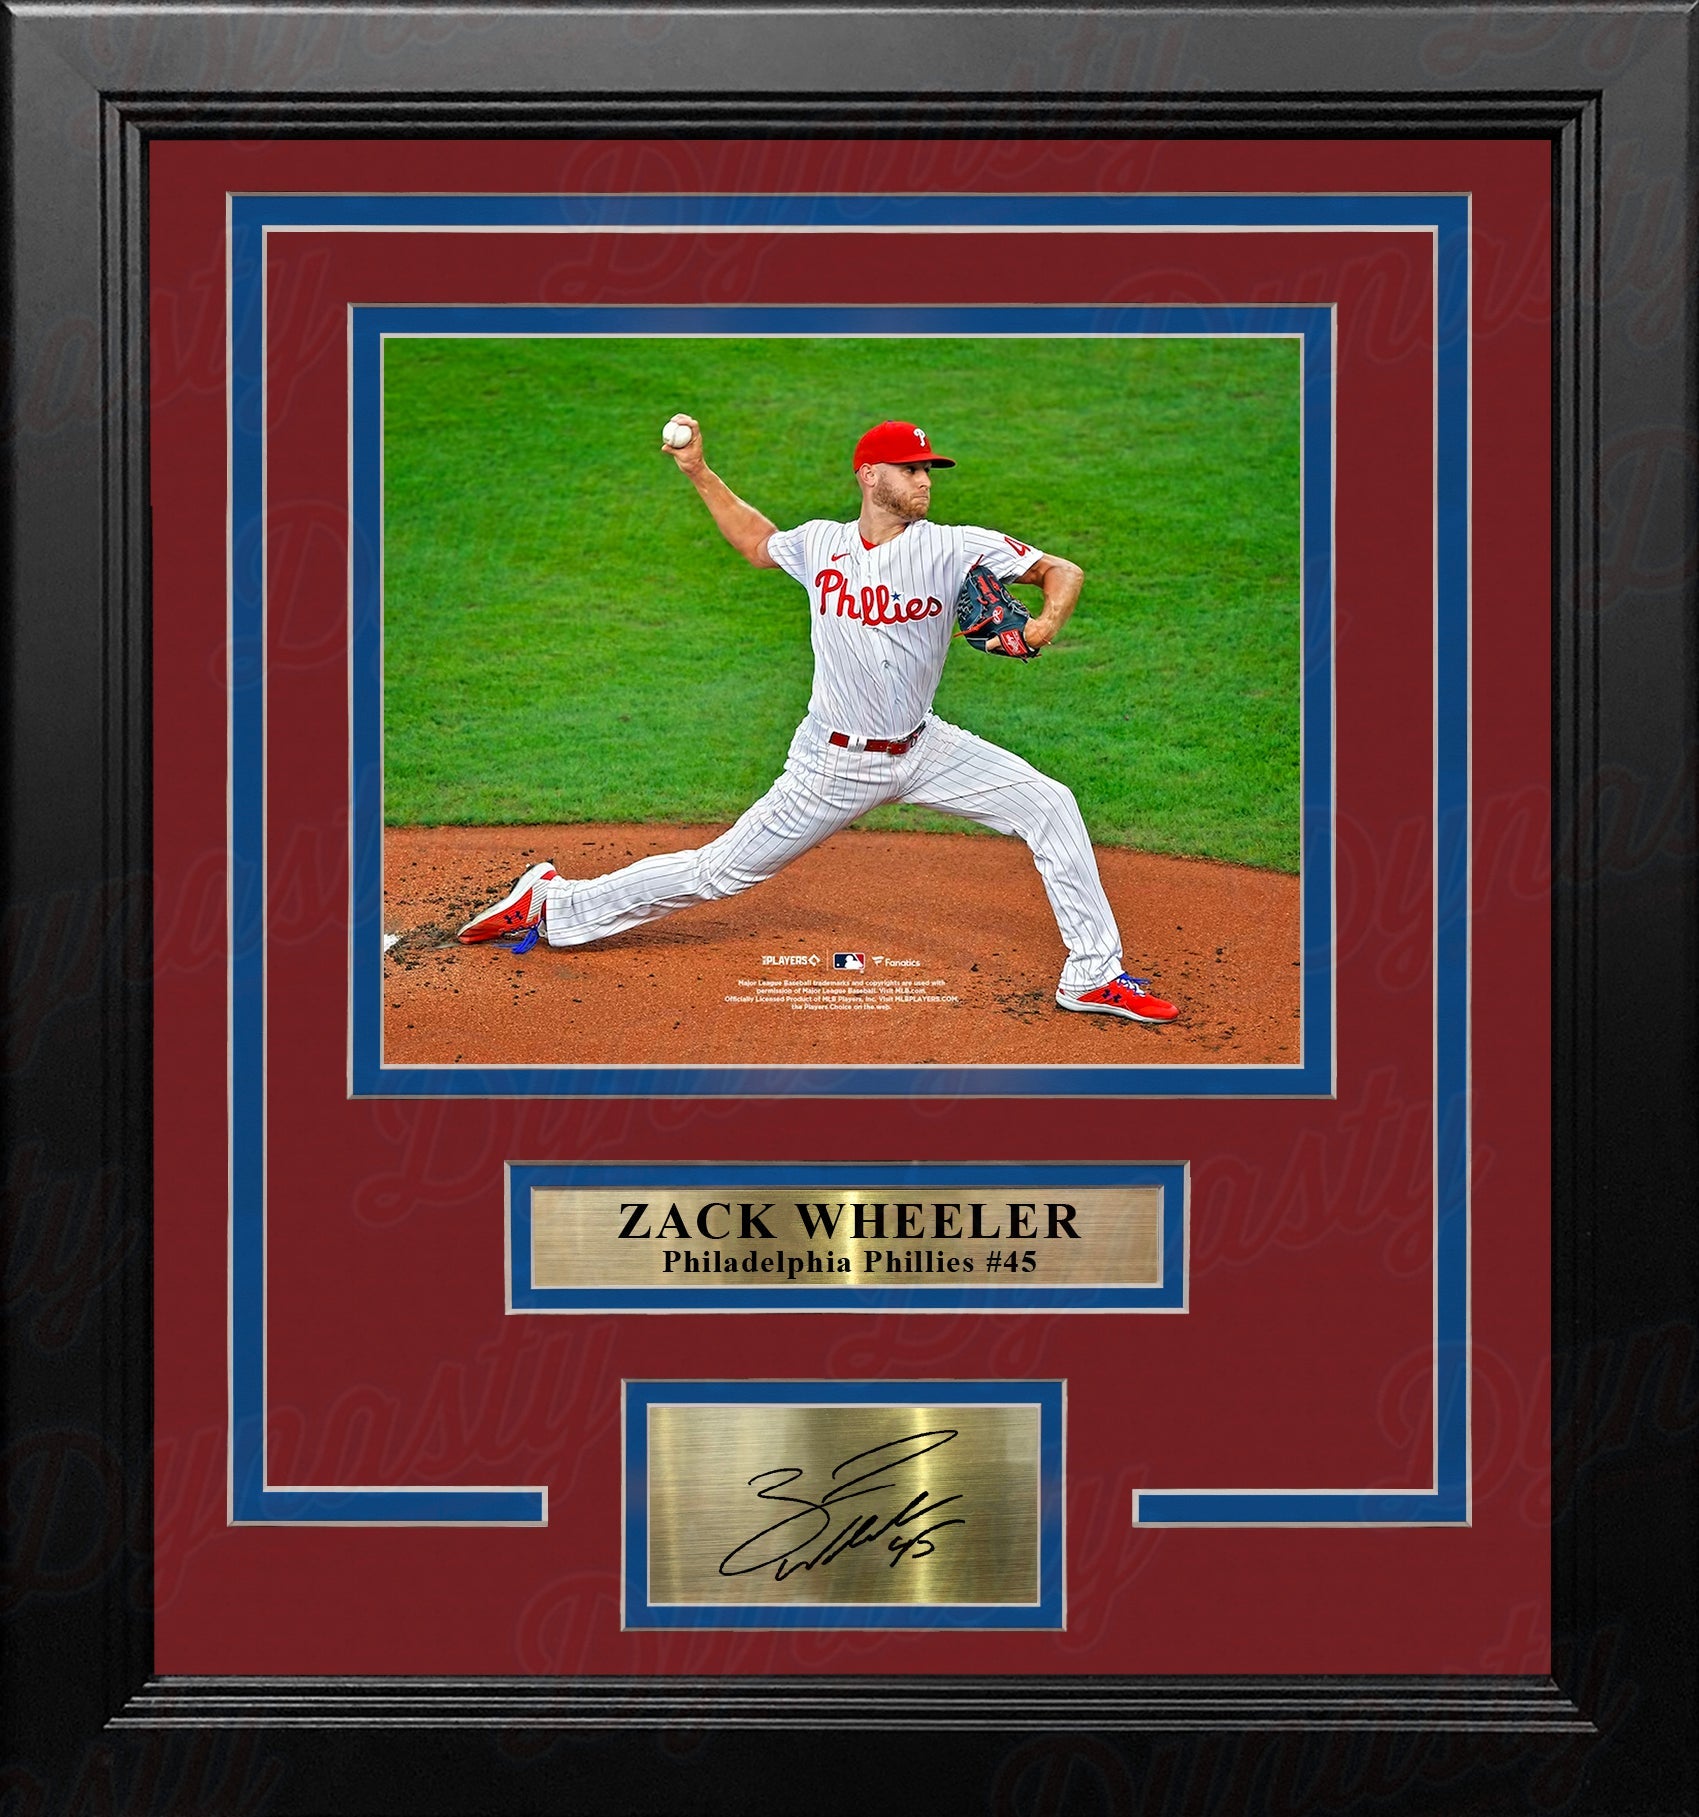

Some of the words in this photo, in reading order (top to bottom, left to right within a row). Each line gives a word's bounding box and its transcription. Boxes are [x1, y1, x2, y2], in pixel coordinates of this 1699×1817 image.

[913, 428, 926, 447] P
[815, 568, 942, 626] Phllies
[766, 955, 808, 965] PLAYERS
[885, 958, 920, 967] Fanatics
[618, 1202, 778, 1240] ZACK
[795, 1203, 1082, 1240] WHEELER
[662, 1250, 852, 1280] Philadelphia
[864, 1250, 974, 1274] Phillies
[986, 1250, 1037, 1274] #45
